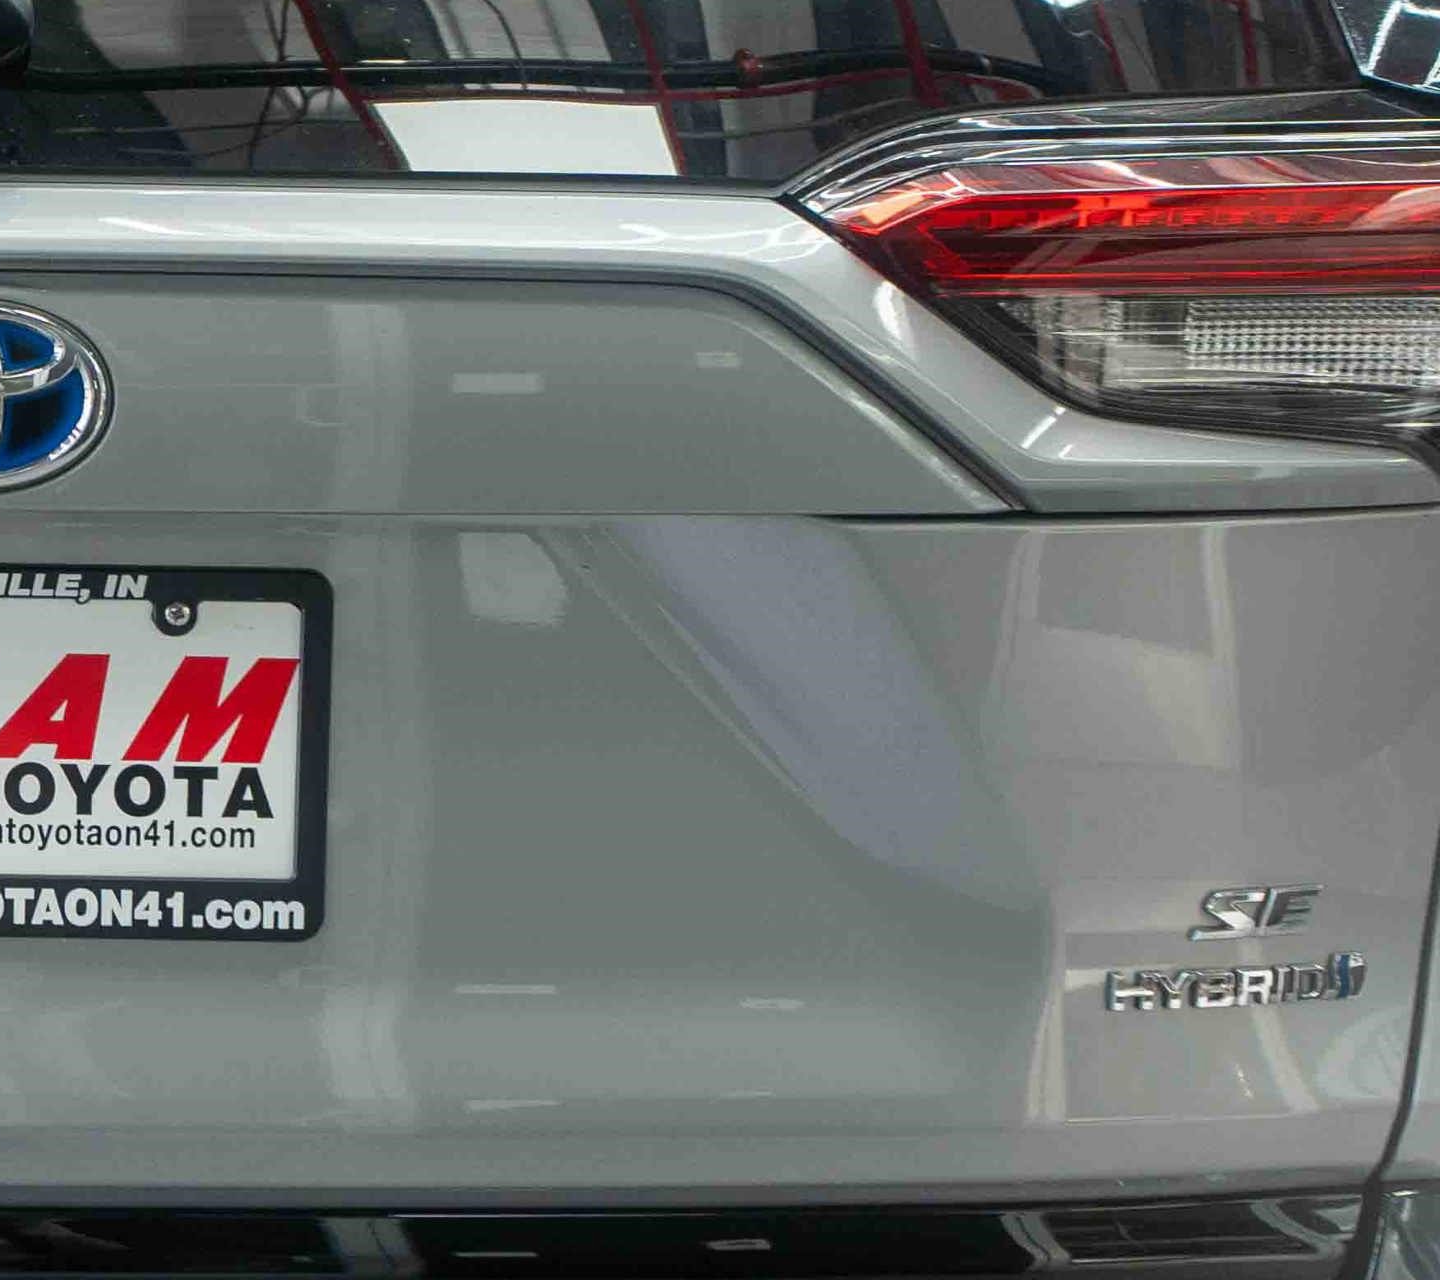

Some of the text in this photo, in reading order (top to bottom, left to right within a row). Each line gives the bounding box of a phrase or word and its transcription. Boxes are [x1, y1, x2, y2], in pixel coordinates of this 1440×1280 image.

[104, 575, 149, 600] IN
[1187, 883, 1323, 941] SE
[1106, 962, 1326, 1011] HYBRID
